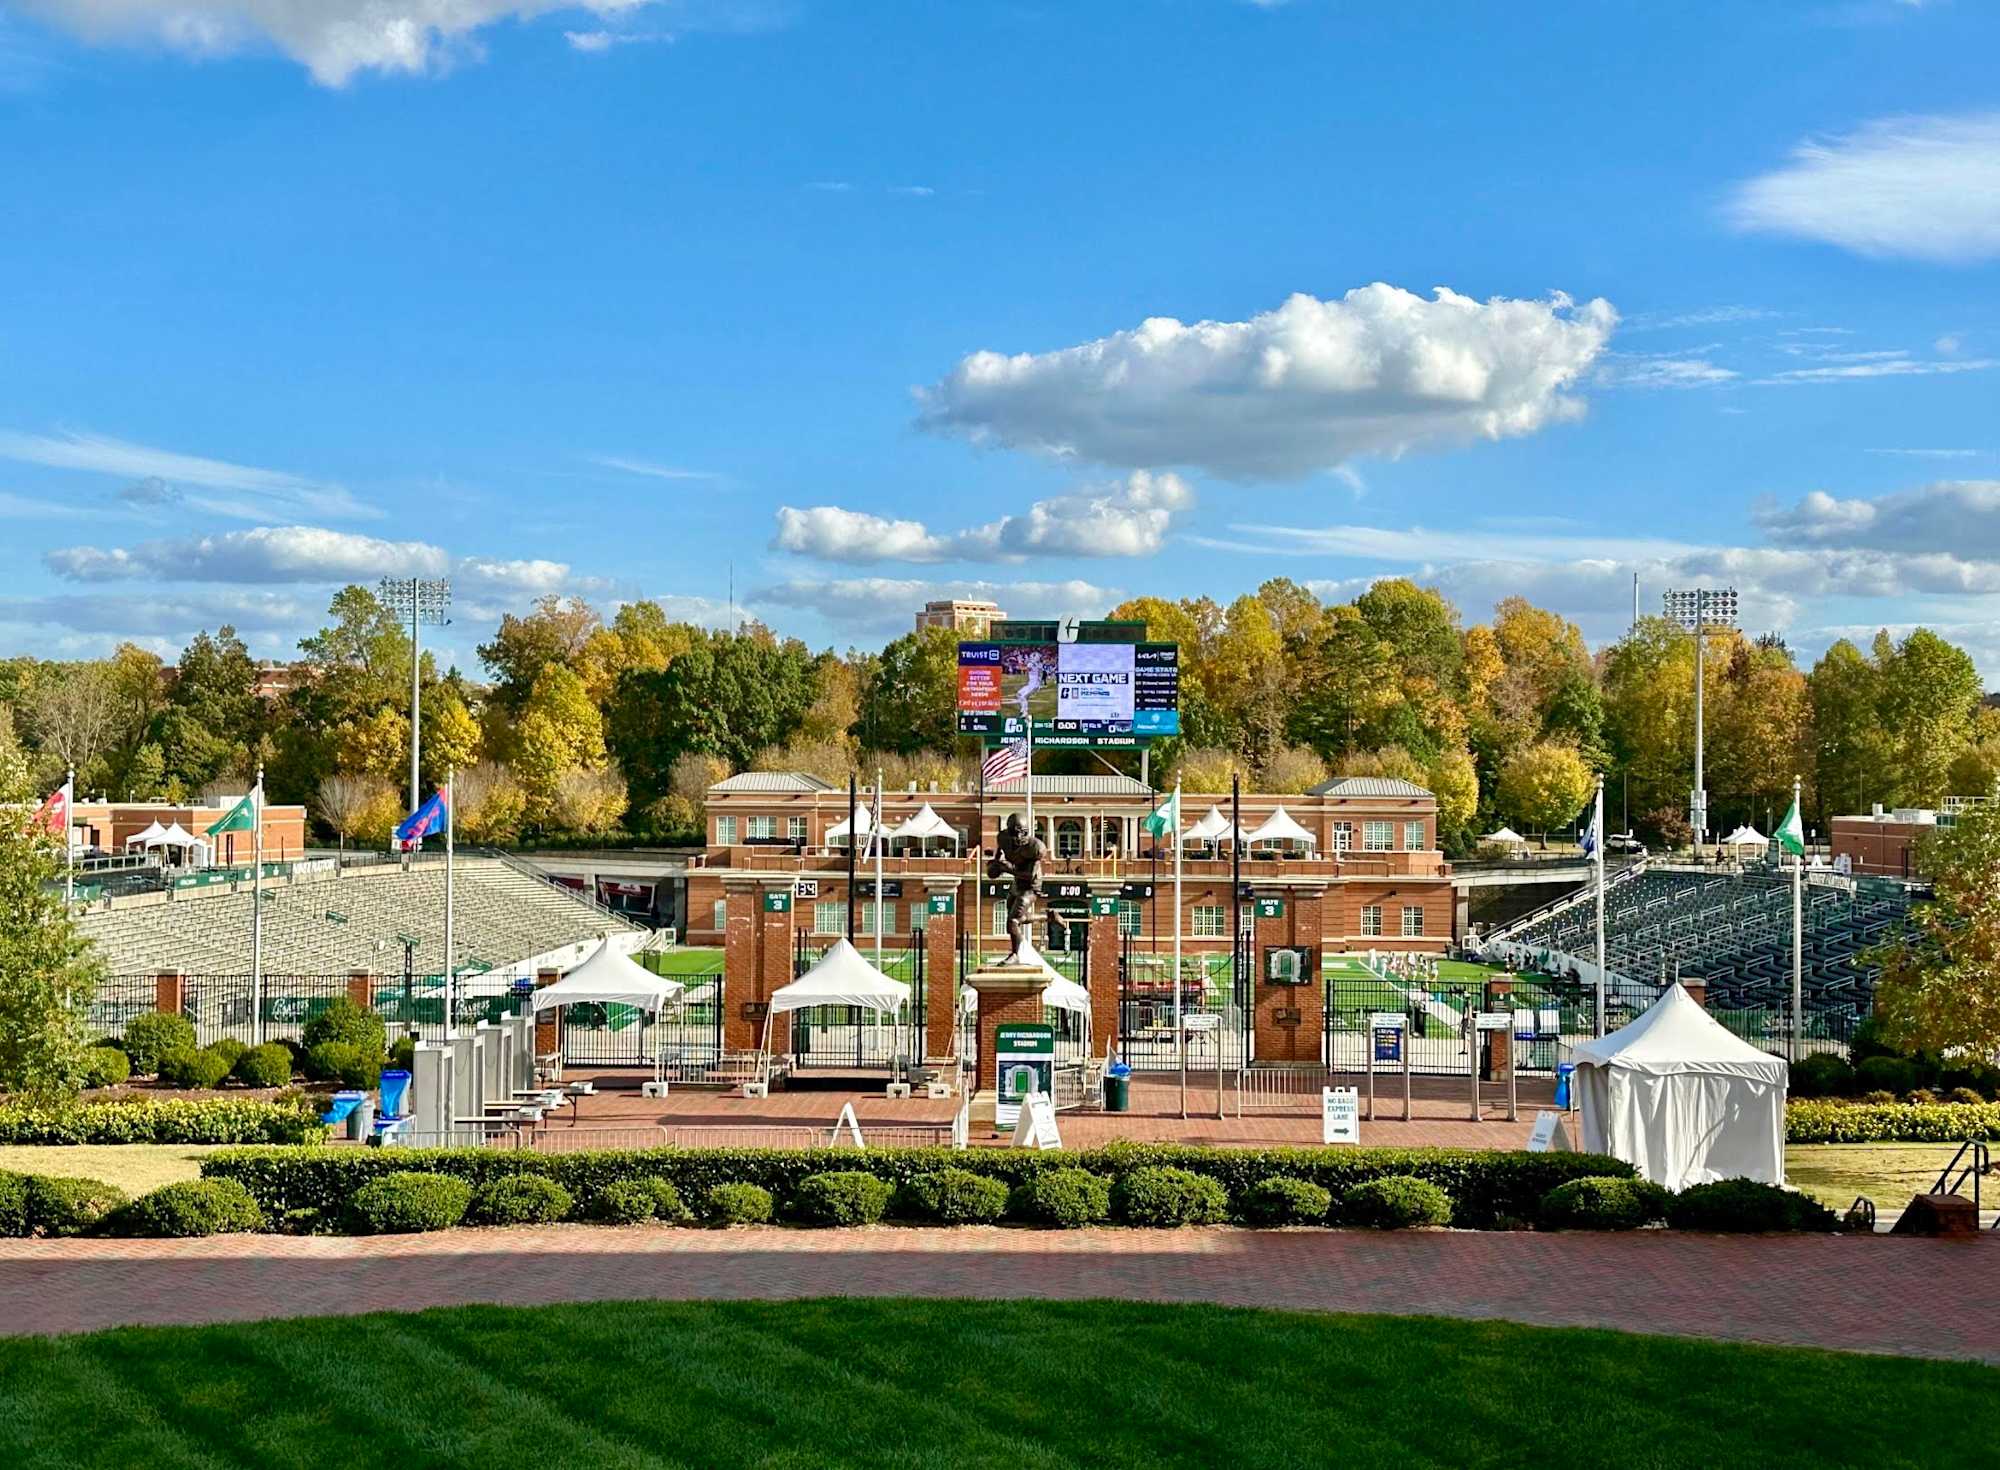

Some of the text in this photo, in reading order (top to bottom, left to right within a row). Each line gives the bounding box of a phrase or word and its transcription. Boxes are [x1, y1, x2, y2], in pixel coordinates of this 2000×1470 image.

[1059, 673, 1091, 684] NEXT
[1091, 673, 1127, 684] GAME
[1034, 737, 1090, 745] RICHARDSON
[1097, 737, 1136, 745] STADIUM
[773, 900, 783, 910] 3
[937, 902, 946, 912] 3
[1100, 904, 1110, 914] 3
[1264, 905, 1275, 916] 3
